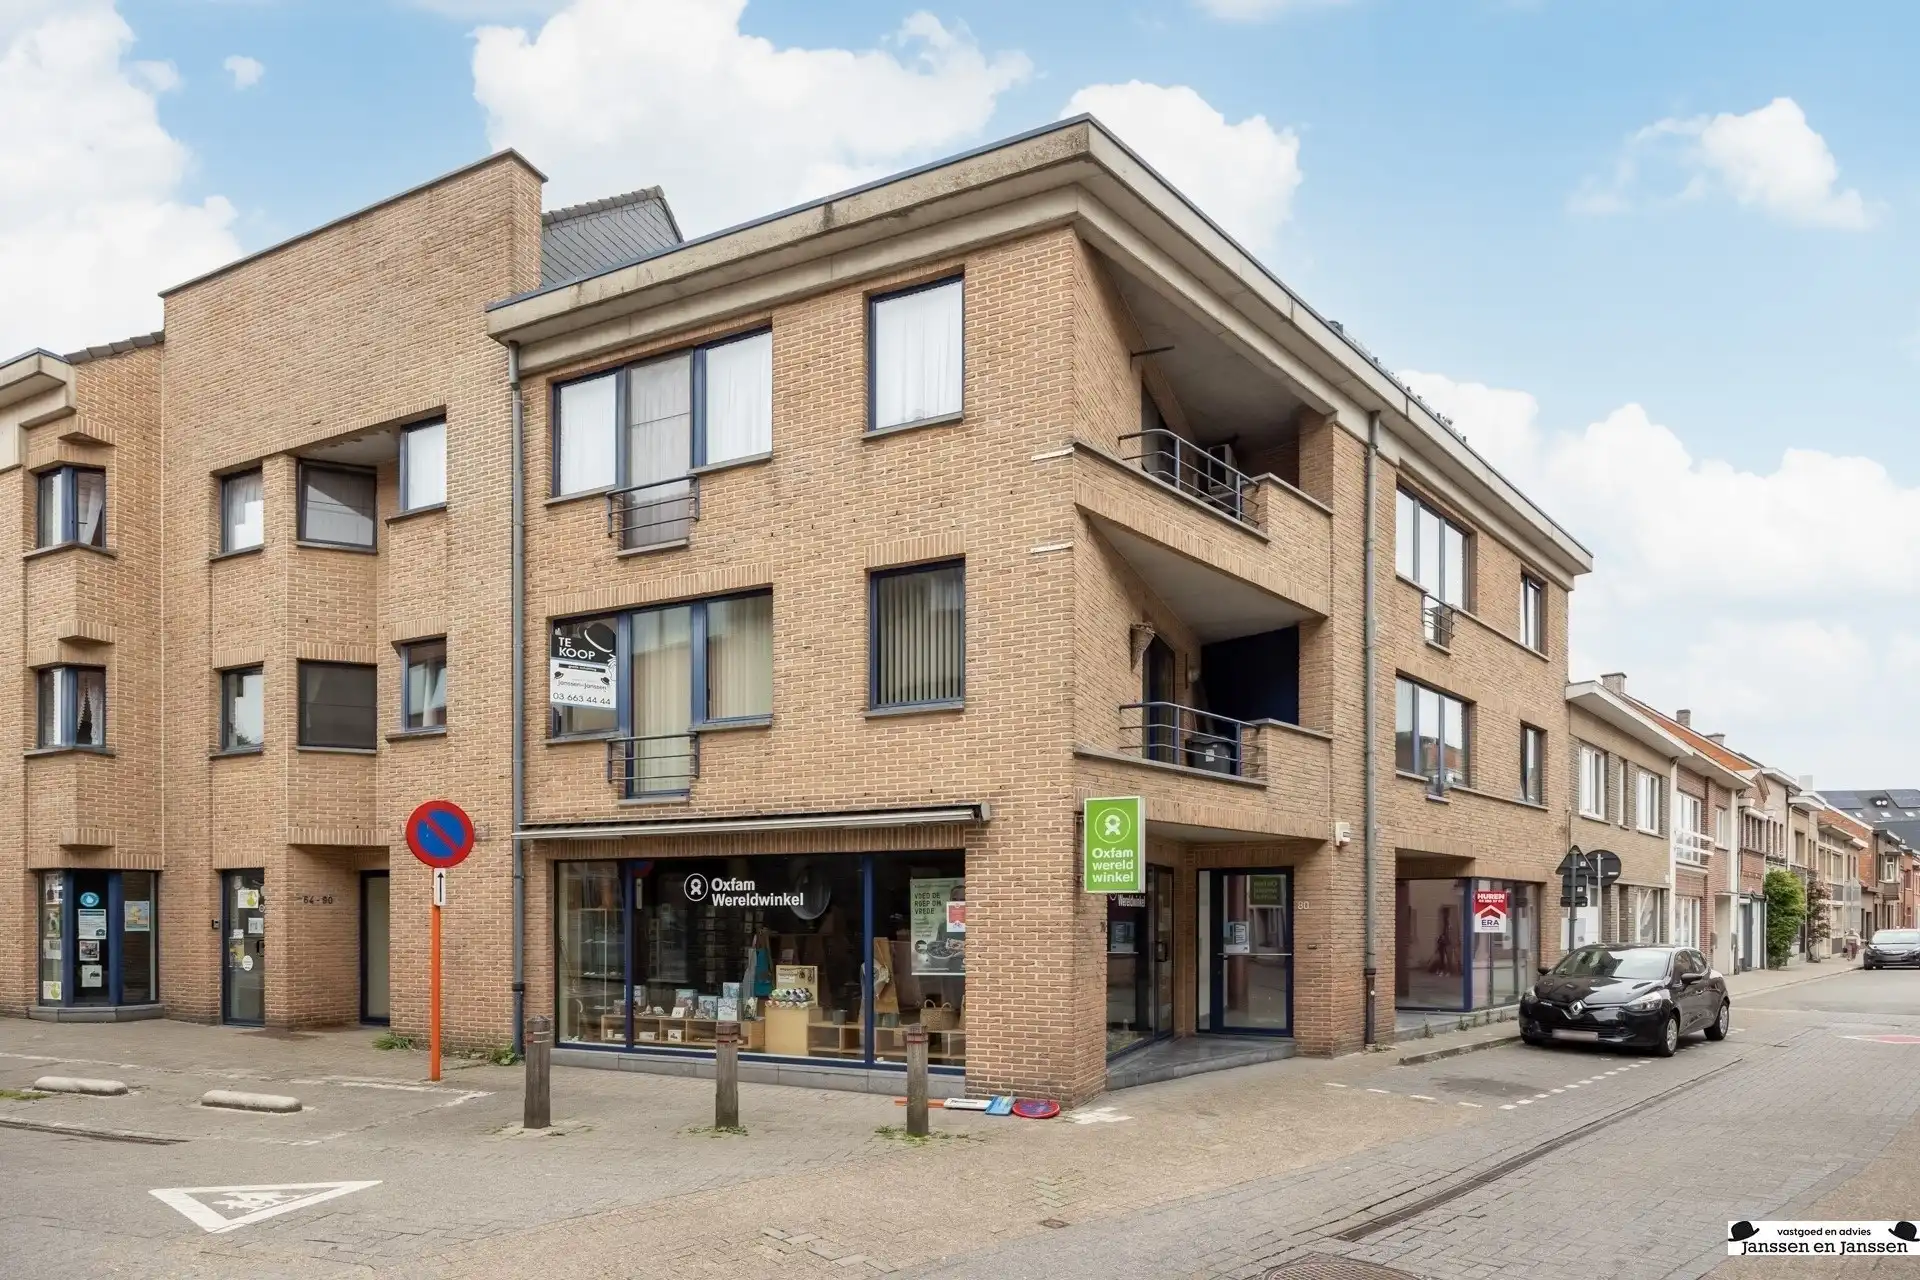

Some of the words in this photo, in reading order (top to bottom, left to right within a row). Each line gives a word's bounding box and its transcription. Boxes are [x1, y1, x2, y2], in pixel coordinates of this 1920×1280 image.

[558, 637, 572, 647] TE
[559, 647, 596, 660] KOOP
[553, 692, 564, 700] 03
[567, 694, 584, 702] 663
[586, 696, 597, 704] 44
[1091, 847, 1134, 859] Oxfam
[1092, 859, 1134, 870] wereld
[1092, 871, 1134, 883] winkel
[711, 877, 756, 892] Oxfam
[711, 893, 804, 907] Wereldwinkel
[1297, 900, 1310, 910] 80
[914, 907, 935, 915] VREDE
